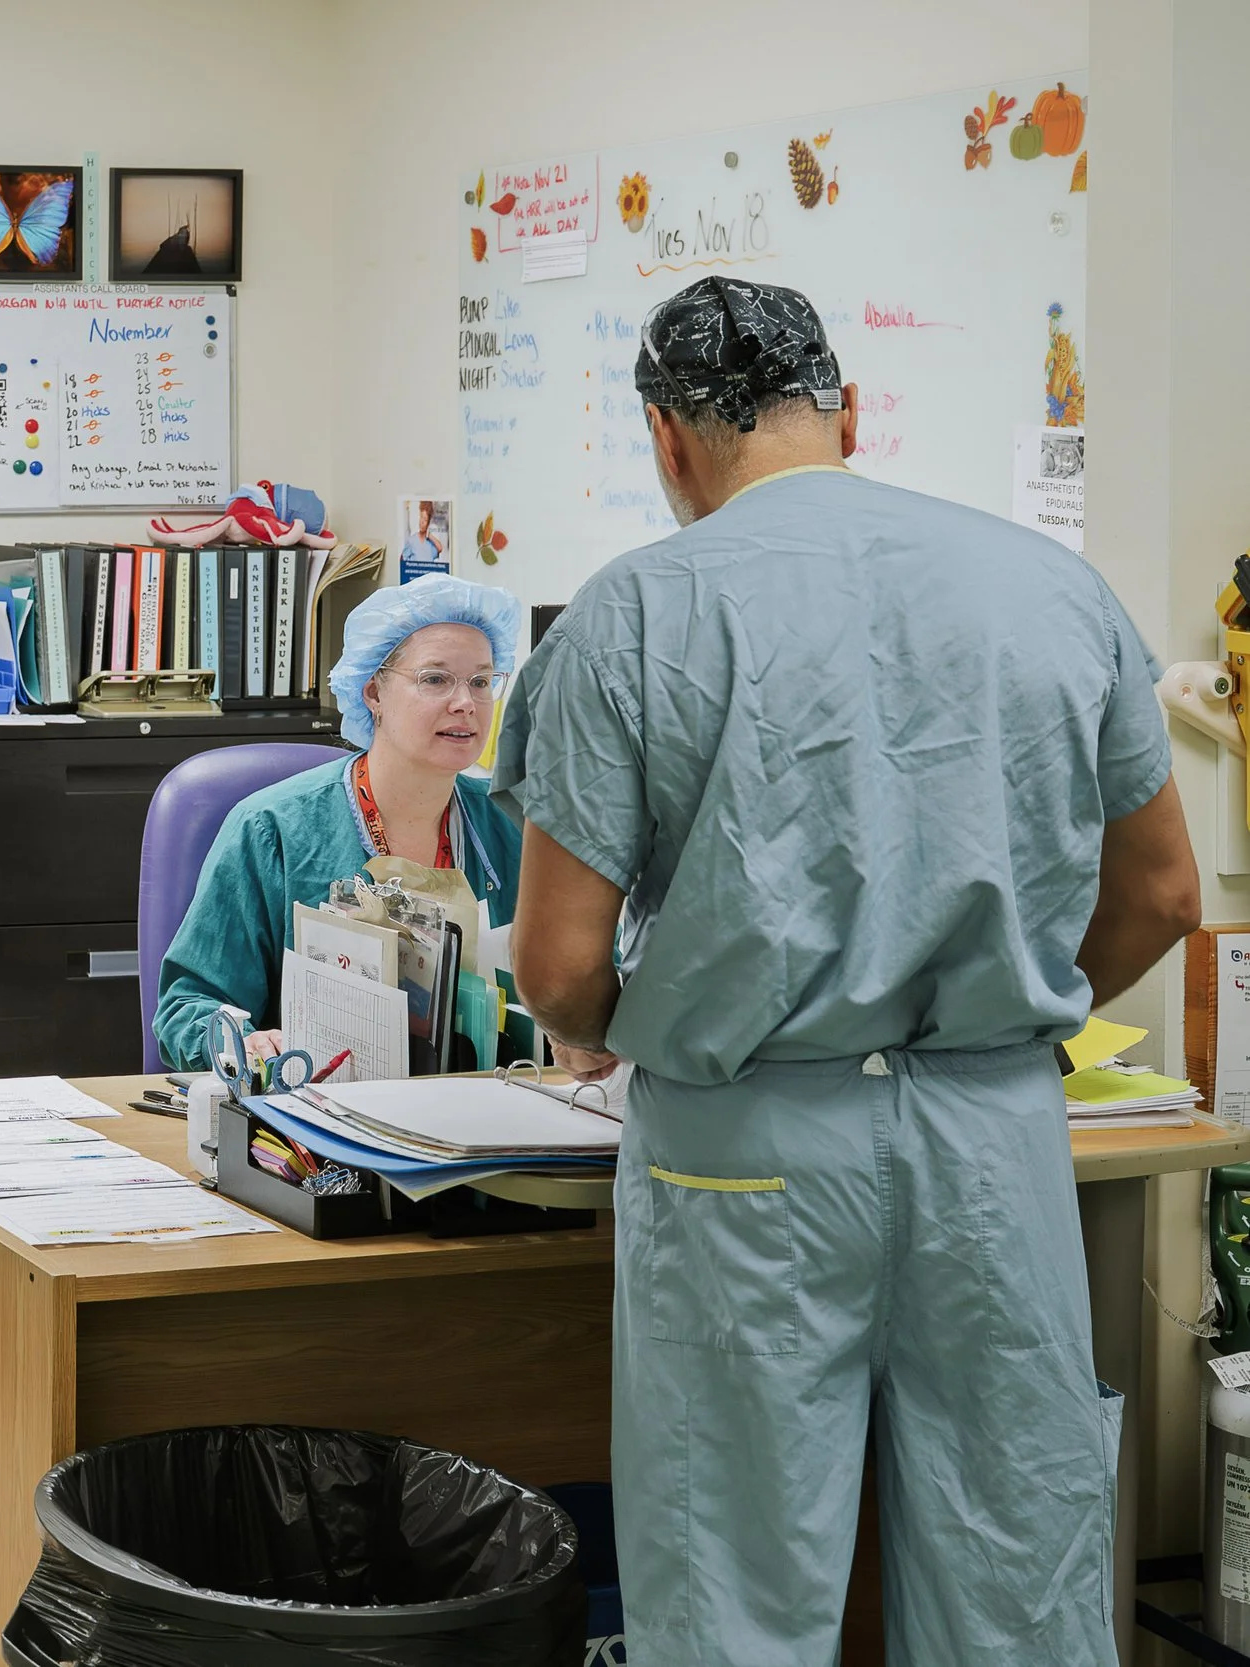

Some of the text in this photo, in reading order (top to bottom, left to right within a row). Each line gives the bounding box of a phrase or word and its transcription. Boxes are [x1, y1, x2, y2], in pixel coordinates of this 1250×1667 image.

[554, 163, 567, 183] 21
[694, 196, 736, 256] Nov
[743, 192, 769, 252] 18
[34, 285, 88, 293] ASSISTANTS
[169, 296, 205, 309] NOTICE
[89, 317, 173, 343] November
[135, 352, 149, 364] 23
[65, 373, 77, 388] 18
[135, 368, 150, 382] 24
[138, 383, 151, 395] 25
[66, 391, 78, 403] 19
[136, 399, 153, 411] 26
[66, 407, 78, 418] 20
[140, 412, 153, 426] 27
[67, 420, 78, 431] 21
[68, 434, 82, 449] 22
[141, 428, 157, 444] 28
[71, 464, 91, 479] Any
[1026, 481, 1076, 495] ANAESTHETIST
[1046, 498, 1083, 511] EPIDURALS
[1038, 513, 1071, 528] TUESDAY,
[100, 559, 108, 596] PHONE
[252, 564, 260, 675] ANAESTHESIA
[278, 556, 289, 679] CLERK MANUAL
